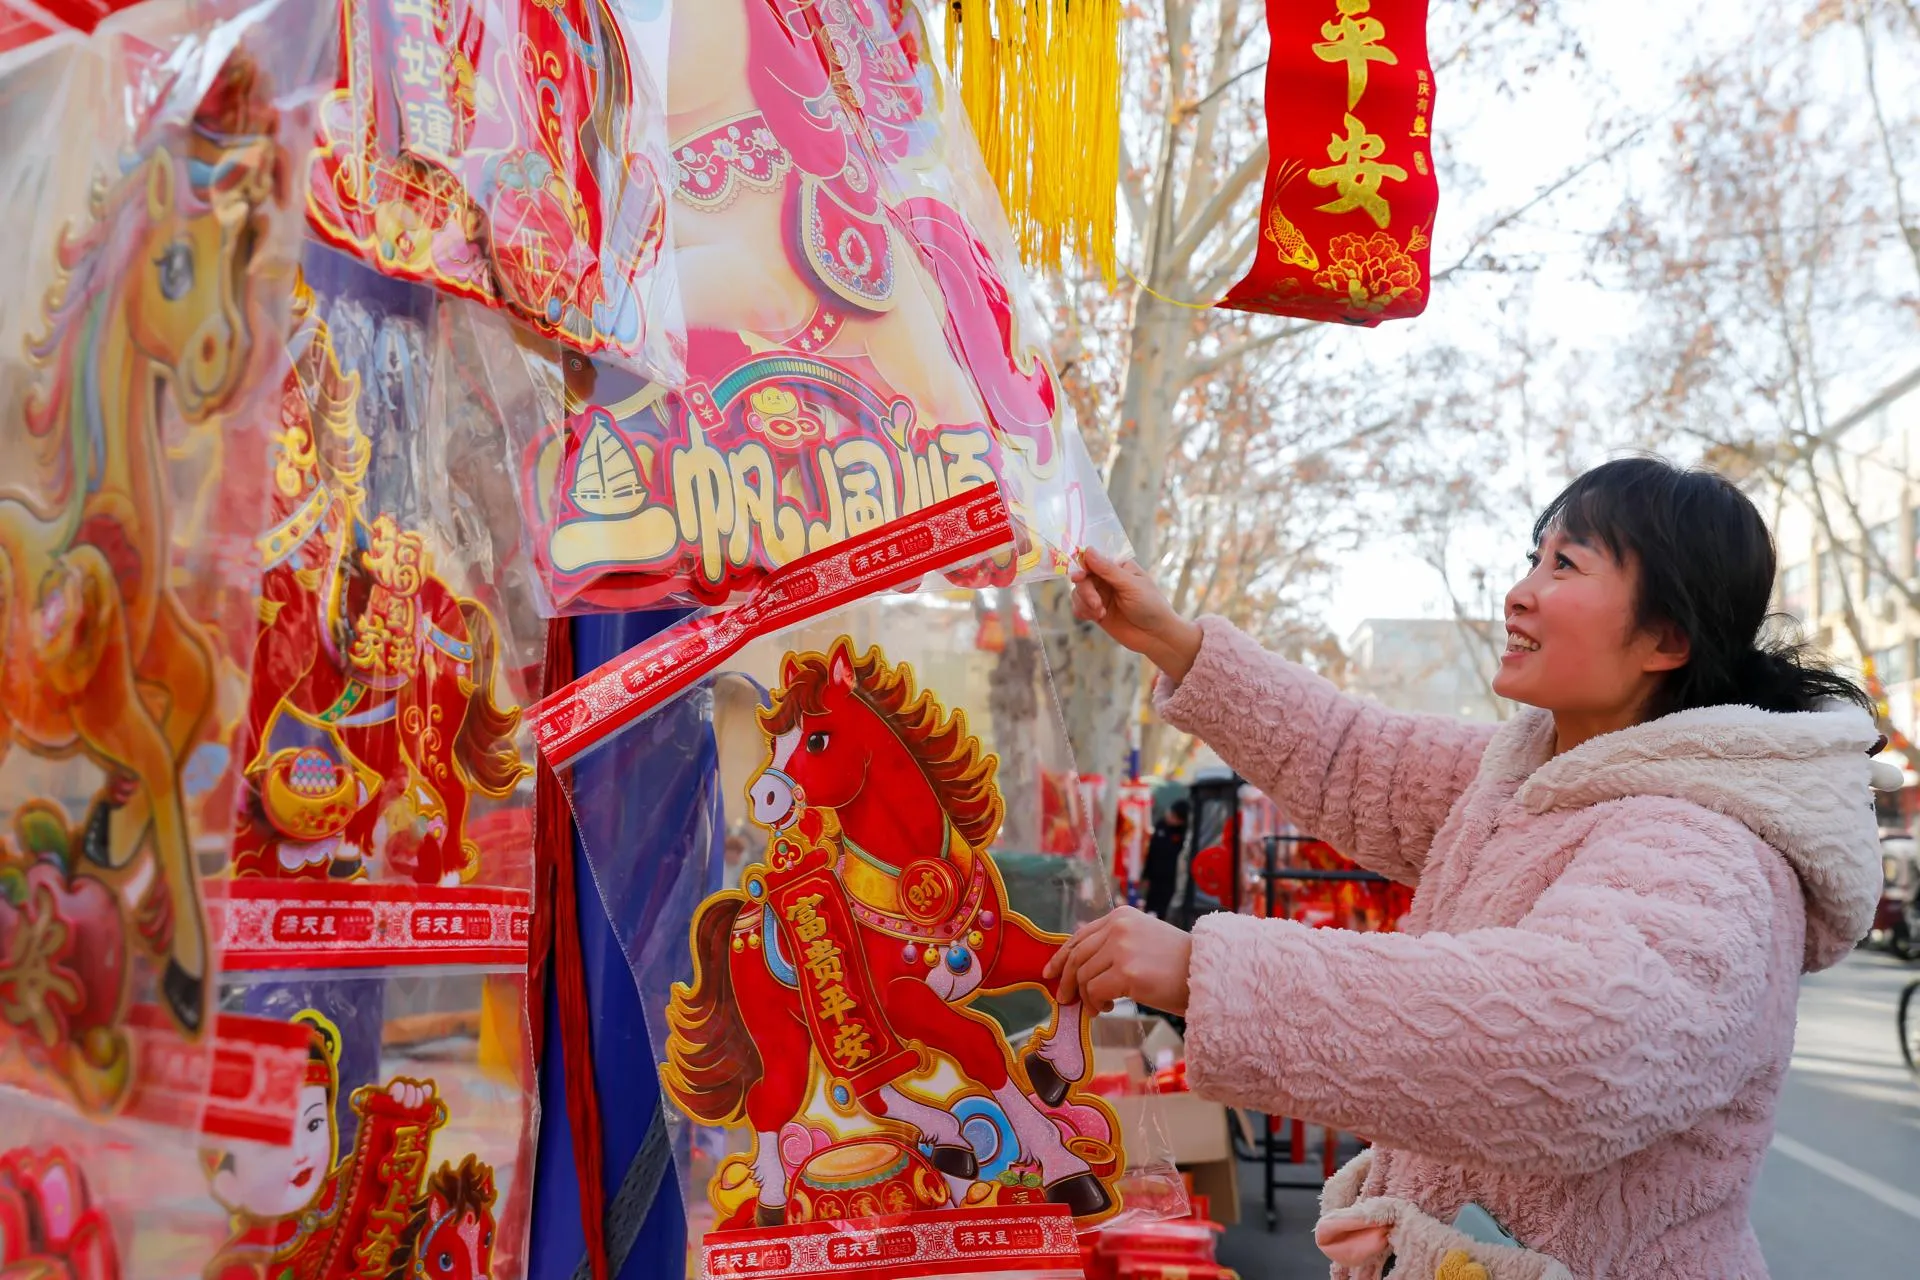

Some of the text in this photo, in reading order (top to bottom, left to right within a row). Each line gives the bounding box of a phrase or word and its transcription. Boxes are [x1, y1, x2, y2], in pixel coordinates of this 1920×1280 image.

[1308, 0, 1408, 229] 平安
[855, 544, 903, 571] 满天星
[629, 654, 678, 687] 满天星
[280, 915, 337, 935] 满天星
[416, 916, 465, 934] 满天星
[786, 893, 871, 1068] 富贵平安
[960, 1230, 1010, 1247] 满天星
[833, 1240, 882, 1259] 满天星
[713, 1252, 761, 1271] 满天星
